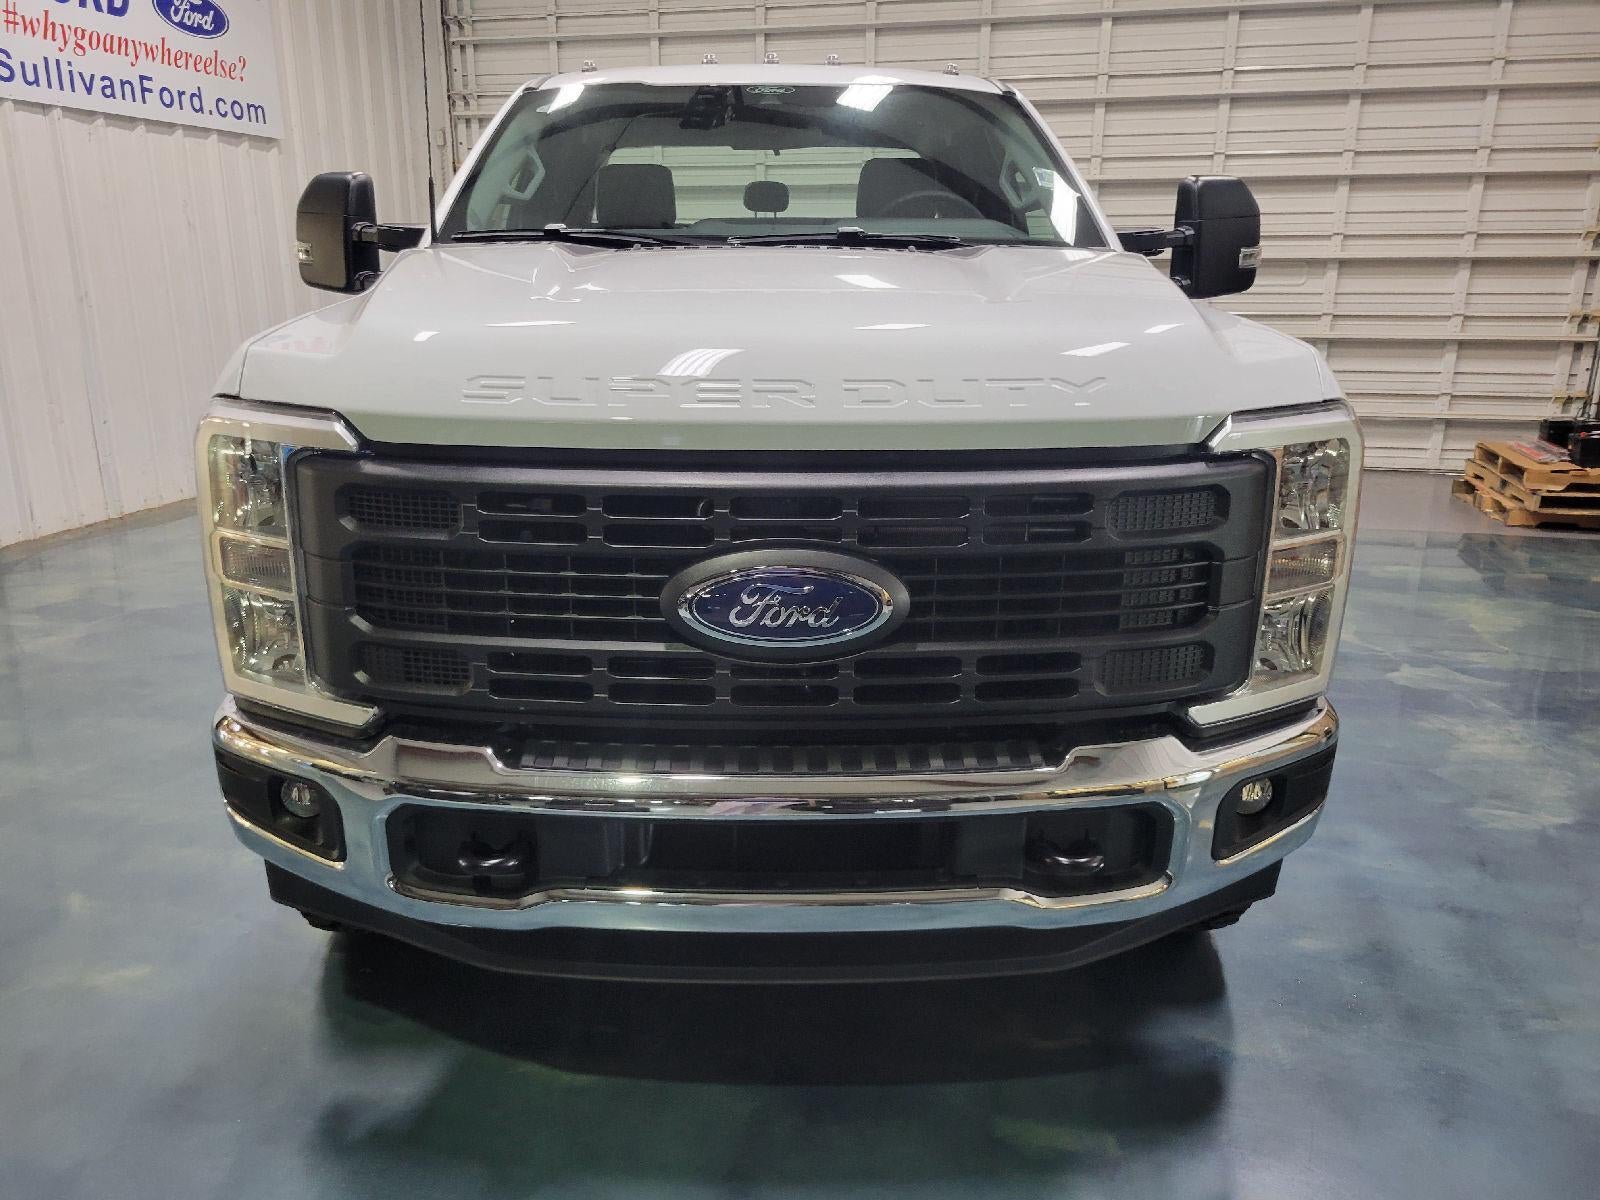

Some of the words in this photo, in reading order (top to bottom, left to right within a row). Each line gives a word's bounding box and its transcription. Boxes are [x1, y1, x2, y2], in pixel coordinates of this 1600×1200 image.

[169, 0, 216, 31] Ford
[2, 0, 247, 82] #whygoanywhereelse?
[0, 48, 267, 125] SullivanFord.com
[461, 375, 815, 408] SUPER
[842, 376, 1107, 408] DUTY
[729, 583, 843, 628] Ford
